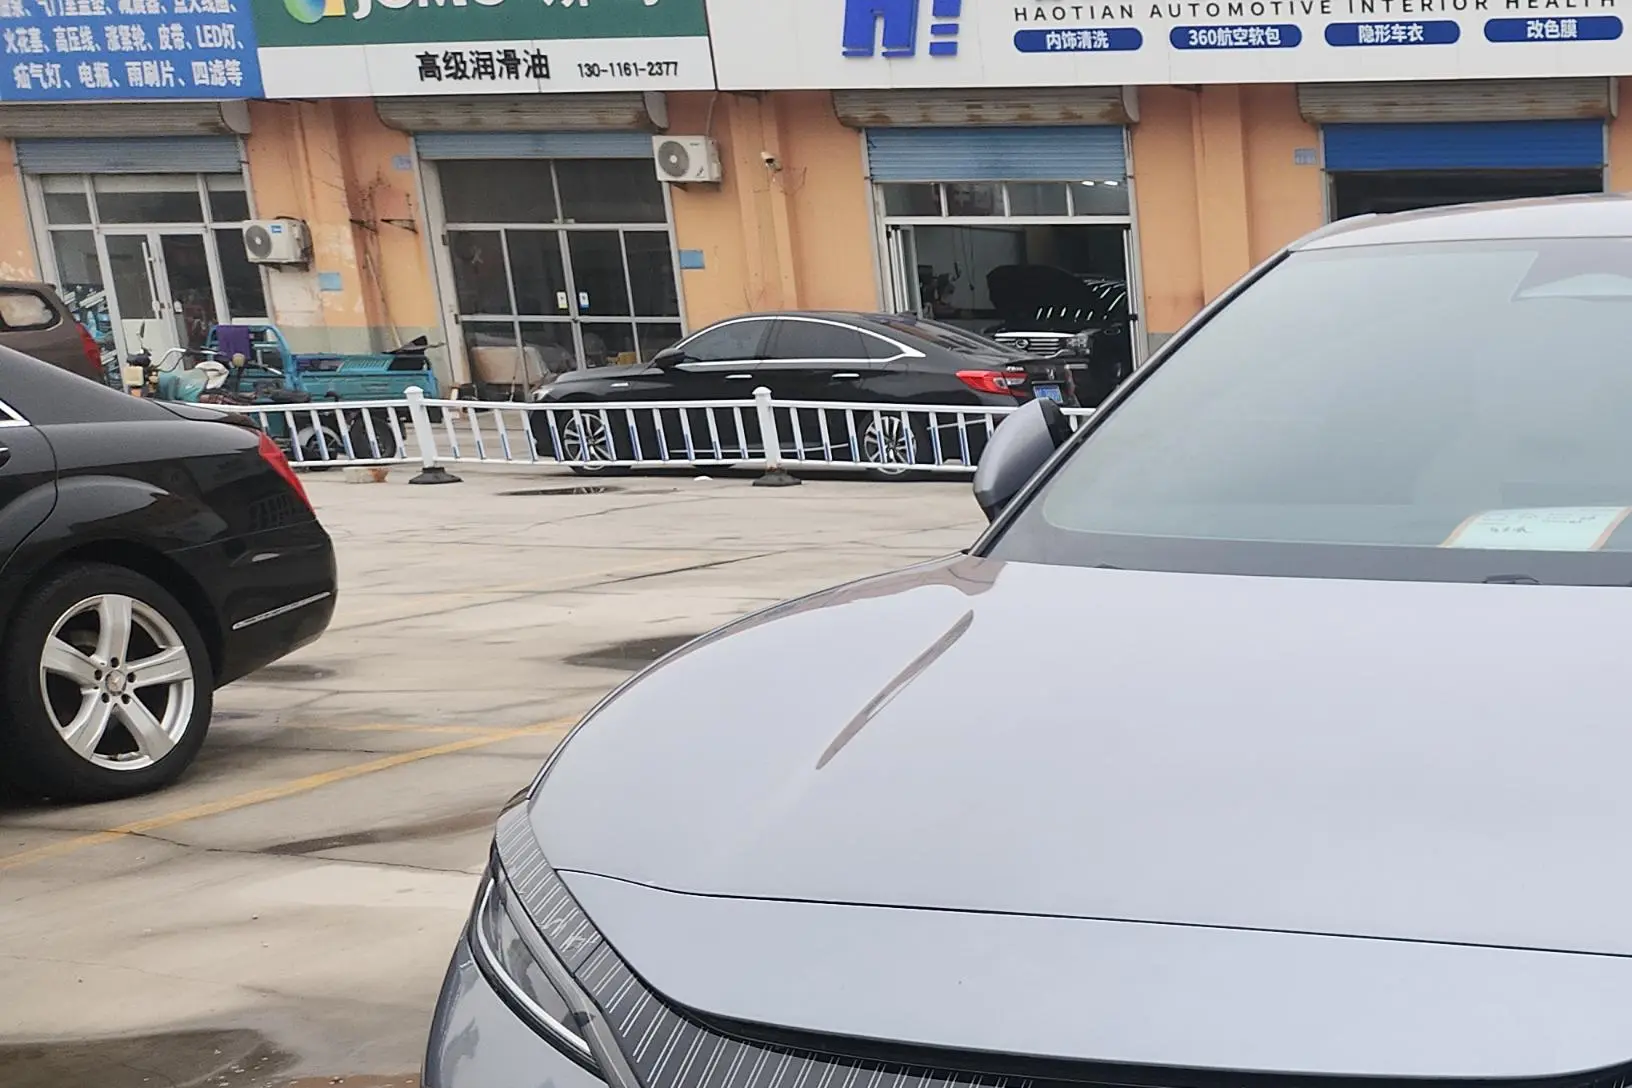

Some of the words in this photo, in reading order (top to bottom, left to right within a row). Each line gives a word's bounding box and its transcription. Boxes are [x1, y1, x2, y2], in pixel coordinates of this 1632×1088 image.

[1014, 4, 1133, 21] HAOTIAN
[1150, 0, 1332, 18] AUTOMOTIVE
[1349, 0, 1488, 13] INTERIOR
[1045, 30, 1110, 50] 内饰清洗
[1188, 27, 1281, 47] 360航空软包
[1358, 23, 1425, 44] 隐形车衣
[1526, 19, 1578, 40] 改色膜
[415, 48, 551, 82] 高级润滑油
[577, 61, 679, 78] 130-1161-2377
